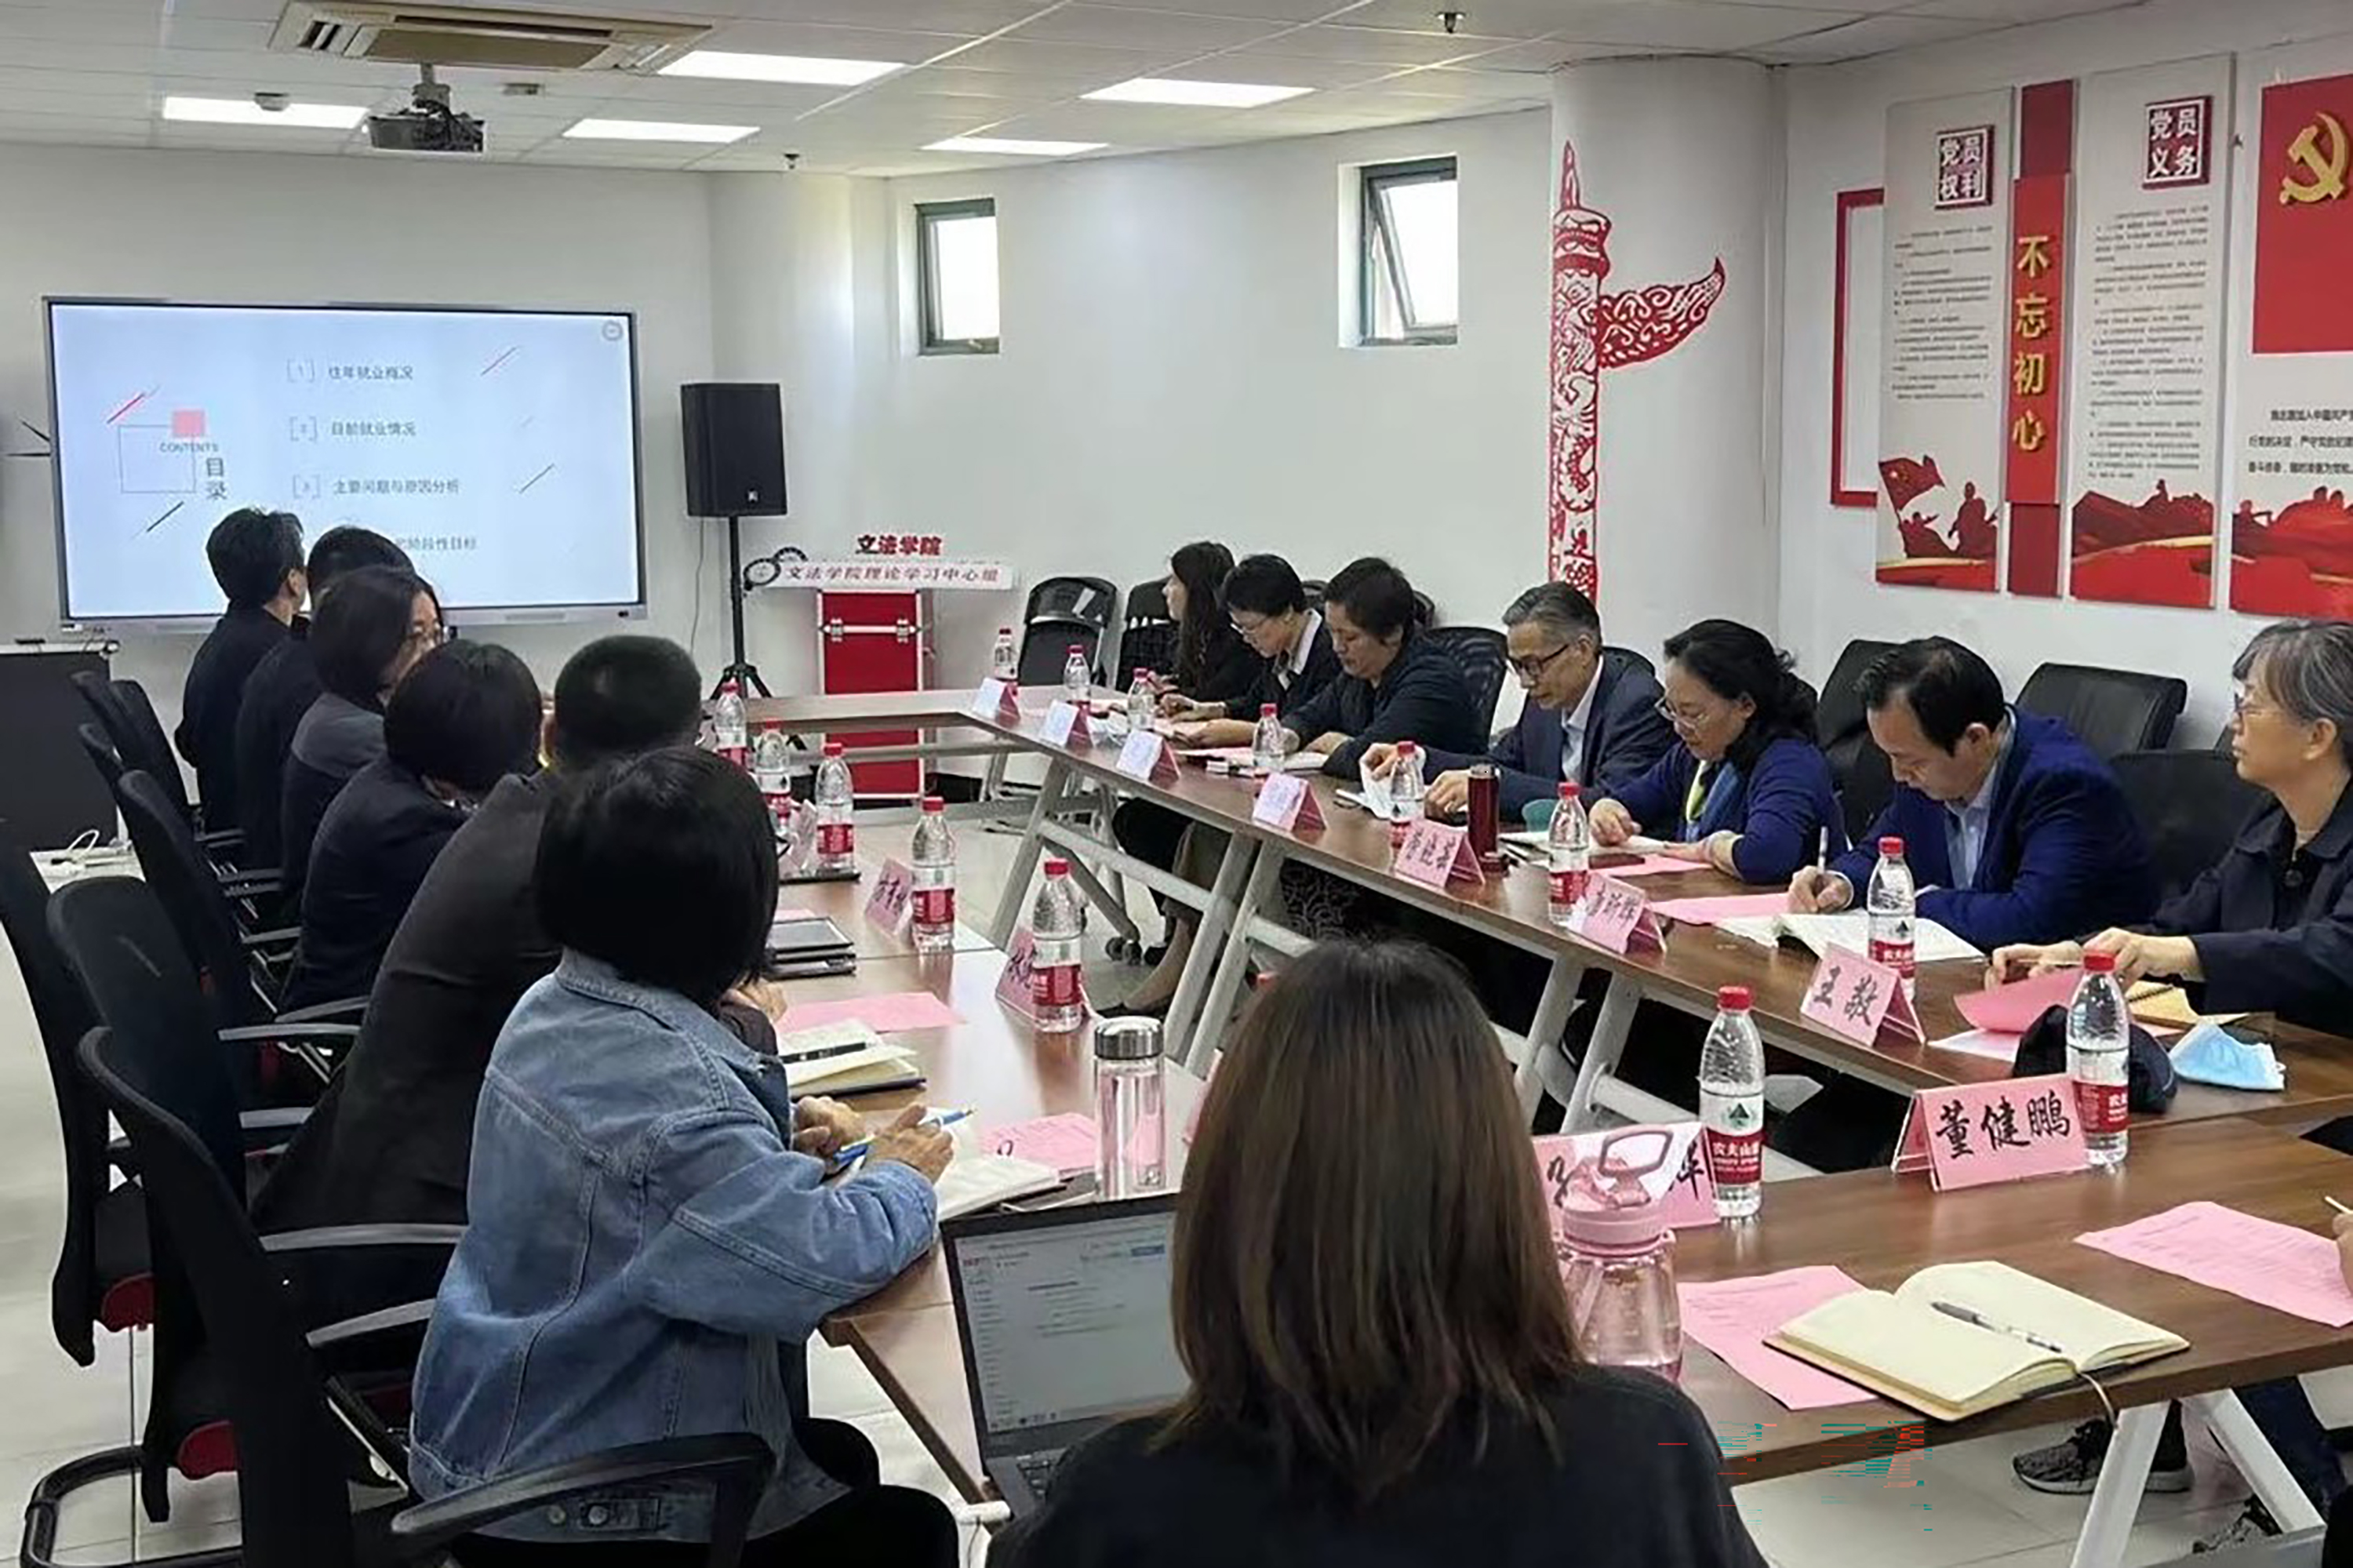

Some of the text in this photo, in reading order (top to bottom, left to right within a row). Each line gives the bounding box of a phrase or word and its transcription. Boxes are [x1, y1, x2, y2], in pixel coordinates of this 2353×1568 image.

[2151, 107, 2197, 140] 党员
[1941, 136, 1981, 166] 党员
[2150, 146, 2196, 176] 义务
[2013, 235, 2049, 451] 不忘初心
[159, 442, 219, 453] CONTENTS
[205, 457, 227, 500] 目录
[856, 534, 942, 555] 文法学院
[787, 566, 998, 581] 文法学院理论学习中心组
[1936, 1089, 2071, 1159] 董健鹏
